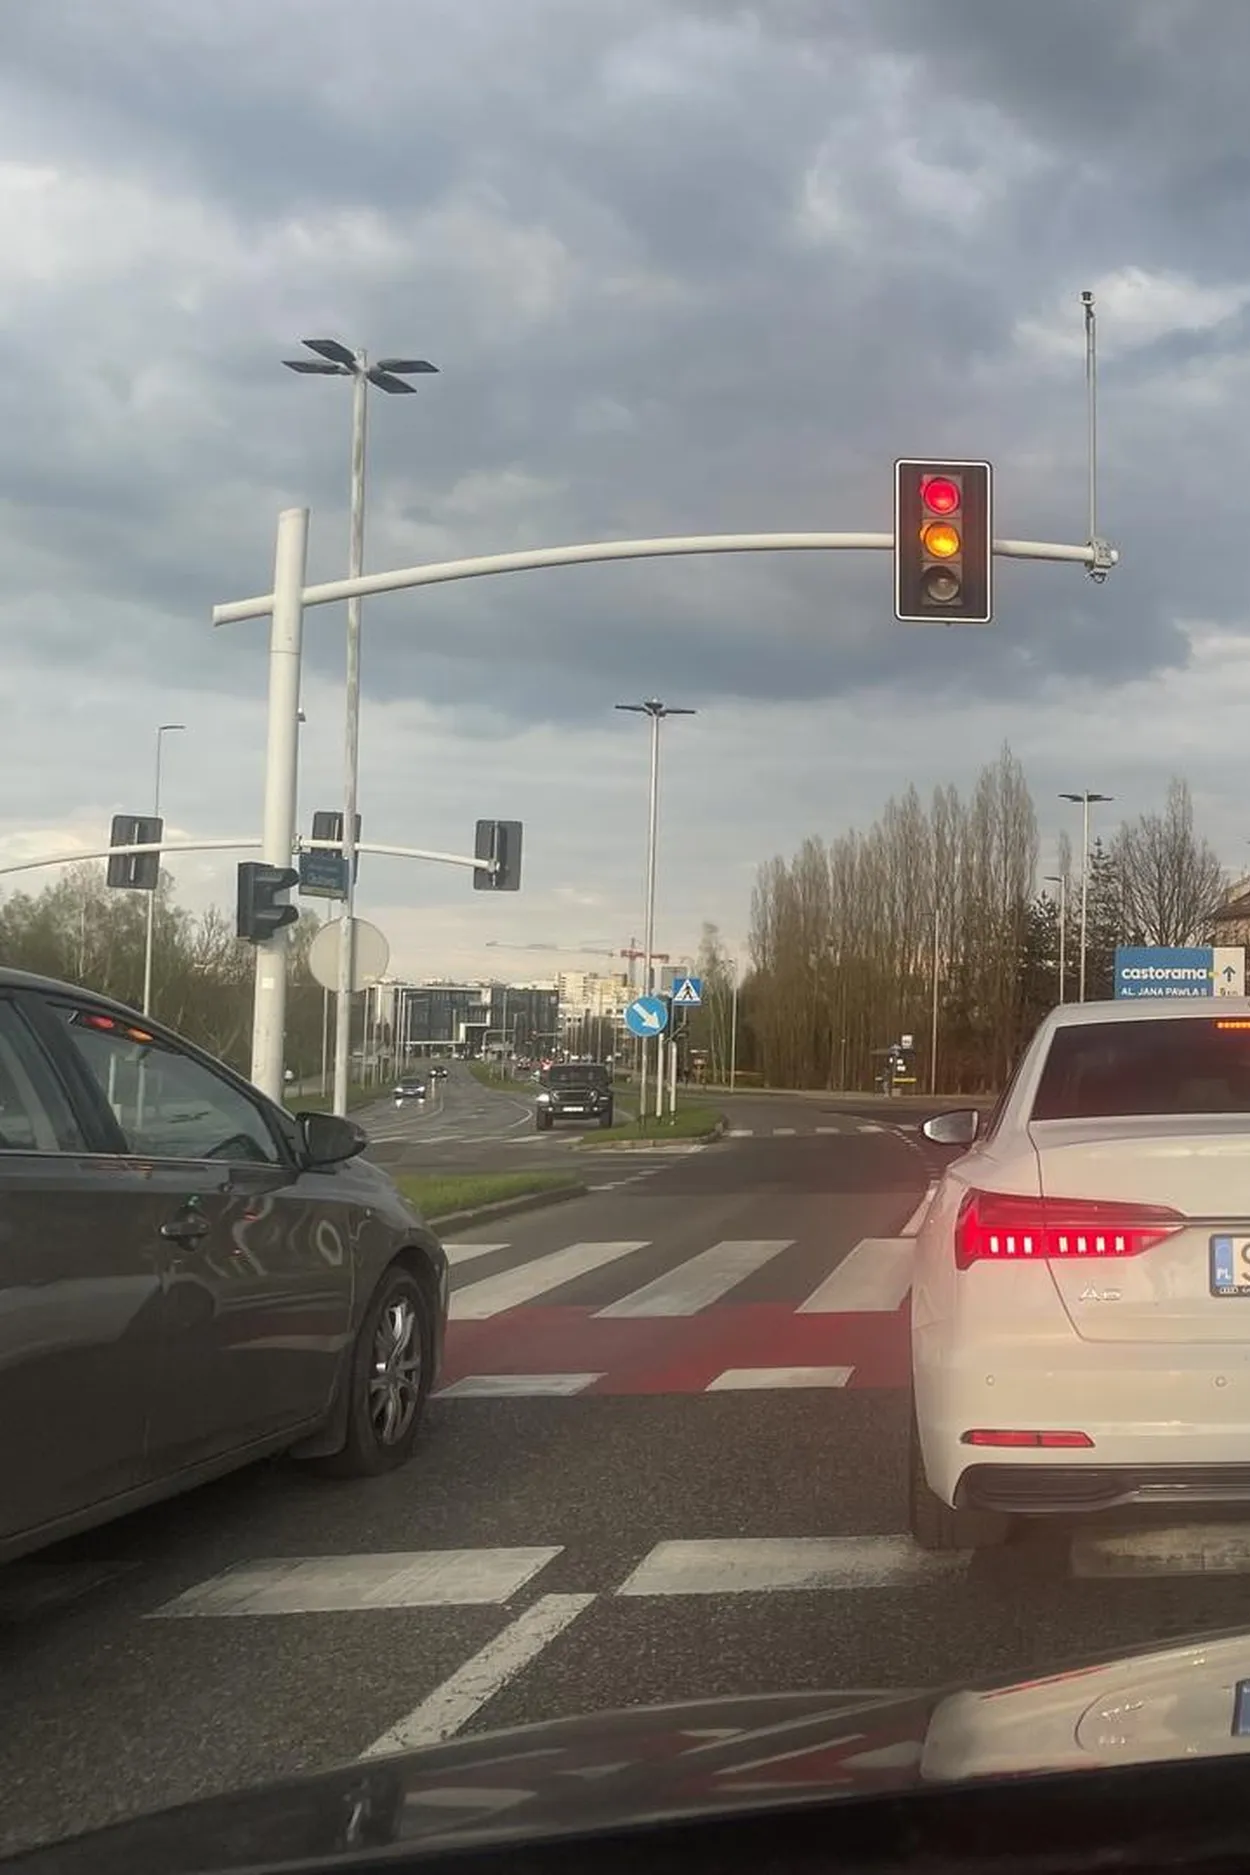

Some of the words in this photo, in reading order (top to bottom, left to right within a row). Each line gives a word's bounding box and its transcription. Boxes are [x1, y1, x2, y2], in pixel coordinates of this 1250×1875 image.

[1121, 966, 1208, 980] castorama
[1138, 987, 1164, 997] JANA
[1216, 1267, 1232, 1280] PL
